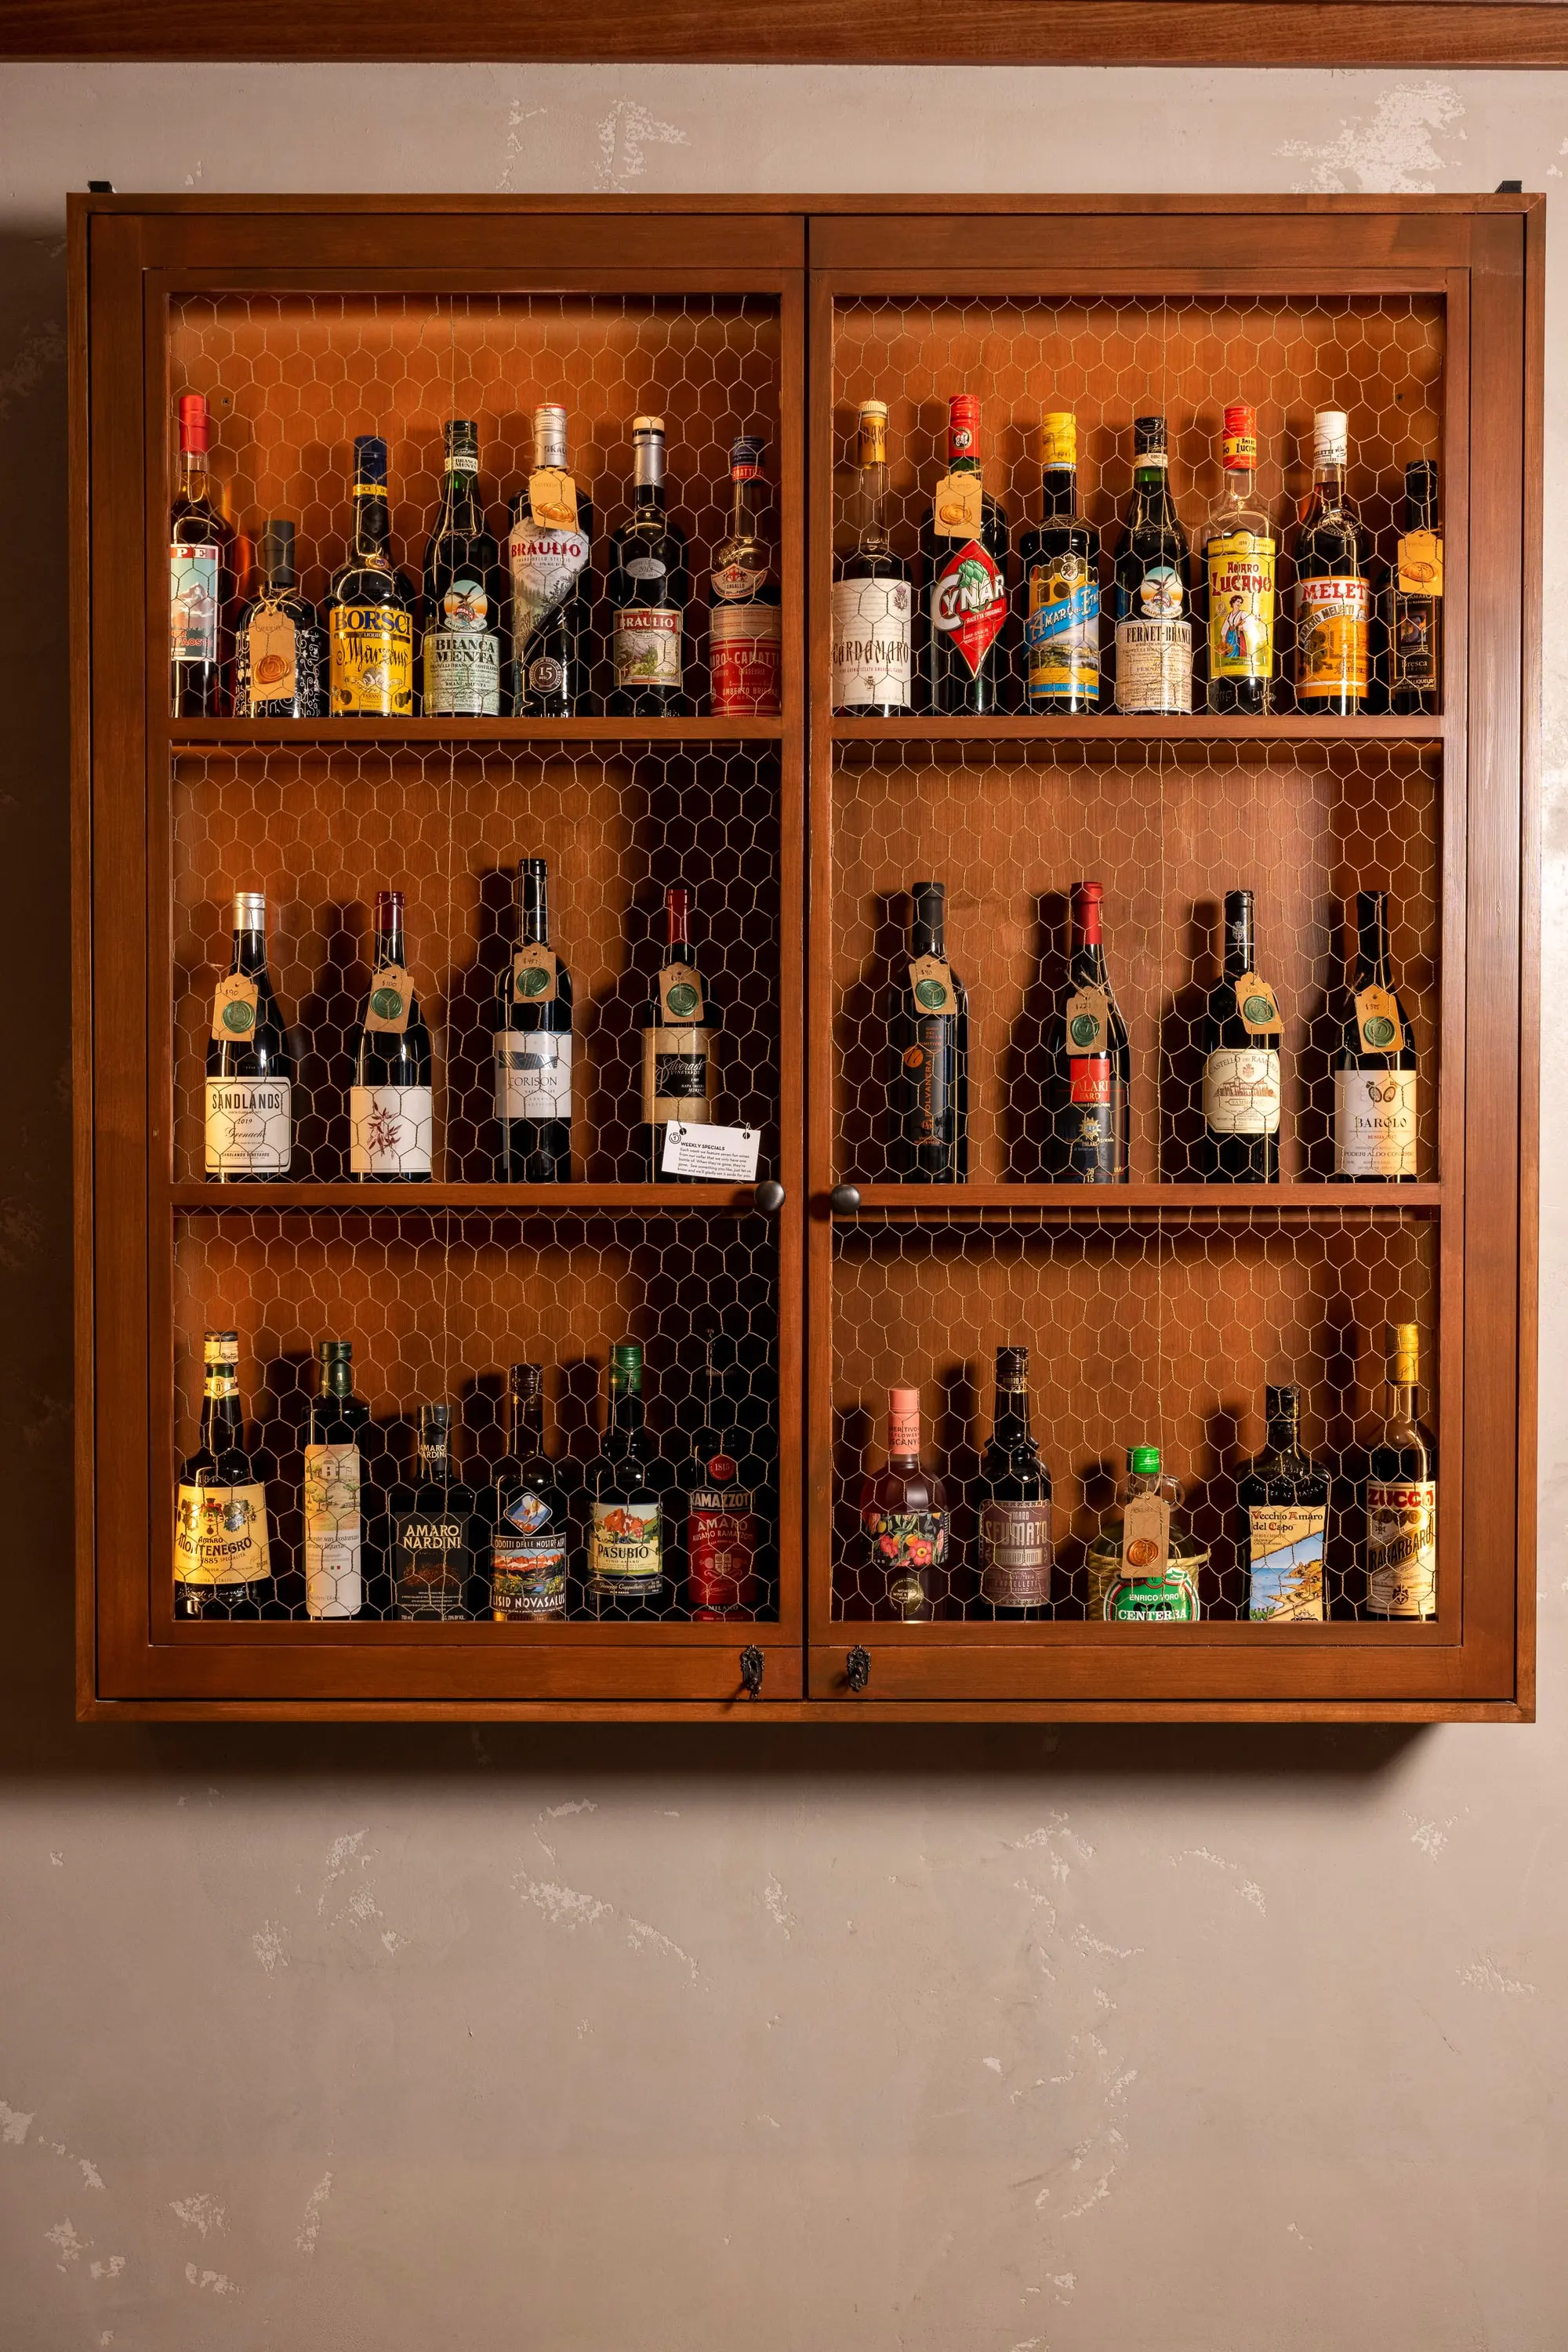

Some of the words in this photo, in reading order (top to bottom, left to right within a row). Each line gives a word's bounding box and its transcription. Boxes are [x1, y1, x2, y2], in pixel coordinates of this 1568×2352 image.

[511, 540, 581, 558] BRÀULIO
[1227, 561, 1259, 574] AMARO
[1212, 572, 1272, 597] LUCANO
[931, 573, 1004, 631] CYNAR
[334, 610, 411, 636] BORSCI
[619, 615, 674, 628] BRÀULIO
[436, 639, 495, 654] BRANCA
[833, 640, 909, 666] CARDAMARO
[436, 652, 495, 665] MENTA
[539, 666, 553, 681] 15
[1209, 1056, 1241, 1074] CASTELLO
[510, 1076, 557, 1087] CORISON
[212, 1093, 280, 1109] SANDLANDS
[1355, 1117, 1407, 1127] BAROLO
[714, 1462, 731, 1472] 1815
[1250, 1511, 1287, 1520] Vecchio
[1288, 1512, 1323, 1520] Amaro
[405, 1524, 459, 1537] AMARO
[698, 1518, 748, 1531] AMARO
[1253, 1523, 1267, 1531] del
[1268, 1522, 1294, 1534] Capo
[985, 1520, 1047, 1546] SFUMATO
[178, 1533, 252, 1556] MONTENEGRO
[403, 1537, 461, 1549] NARDINI
[516, 1540, 534, 1548] DELLE
[598, 1544, 649, 1559] PASUBIO
[1118, 1609, 1187, 1621] CENTERBA
